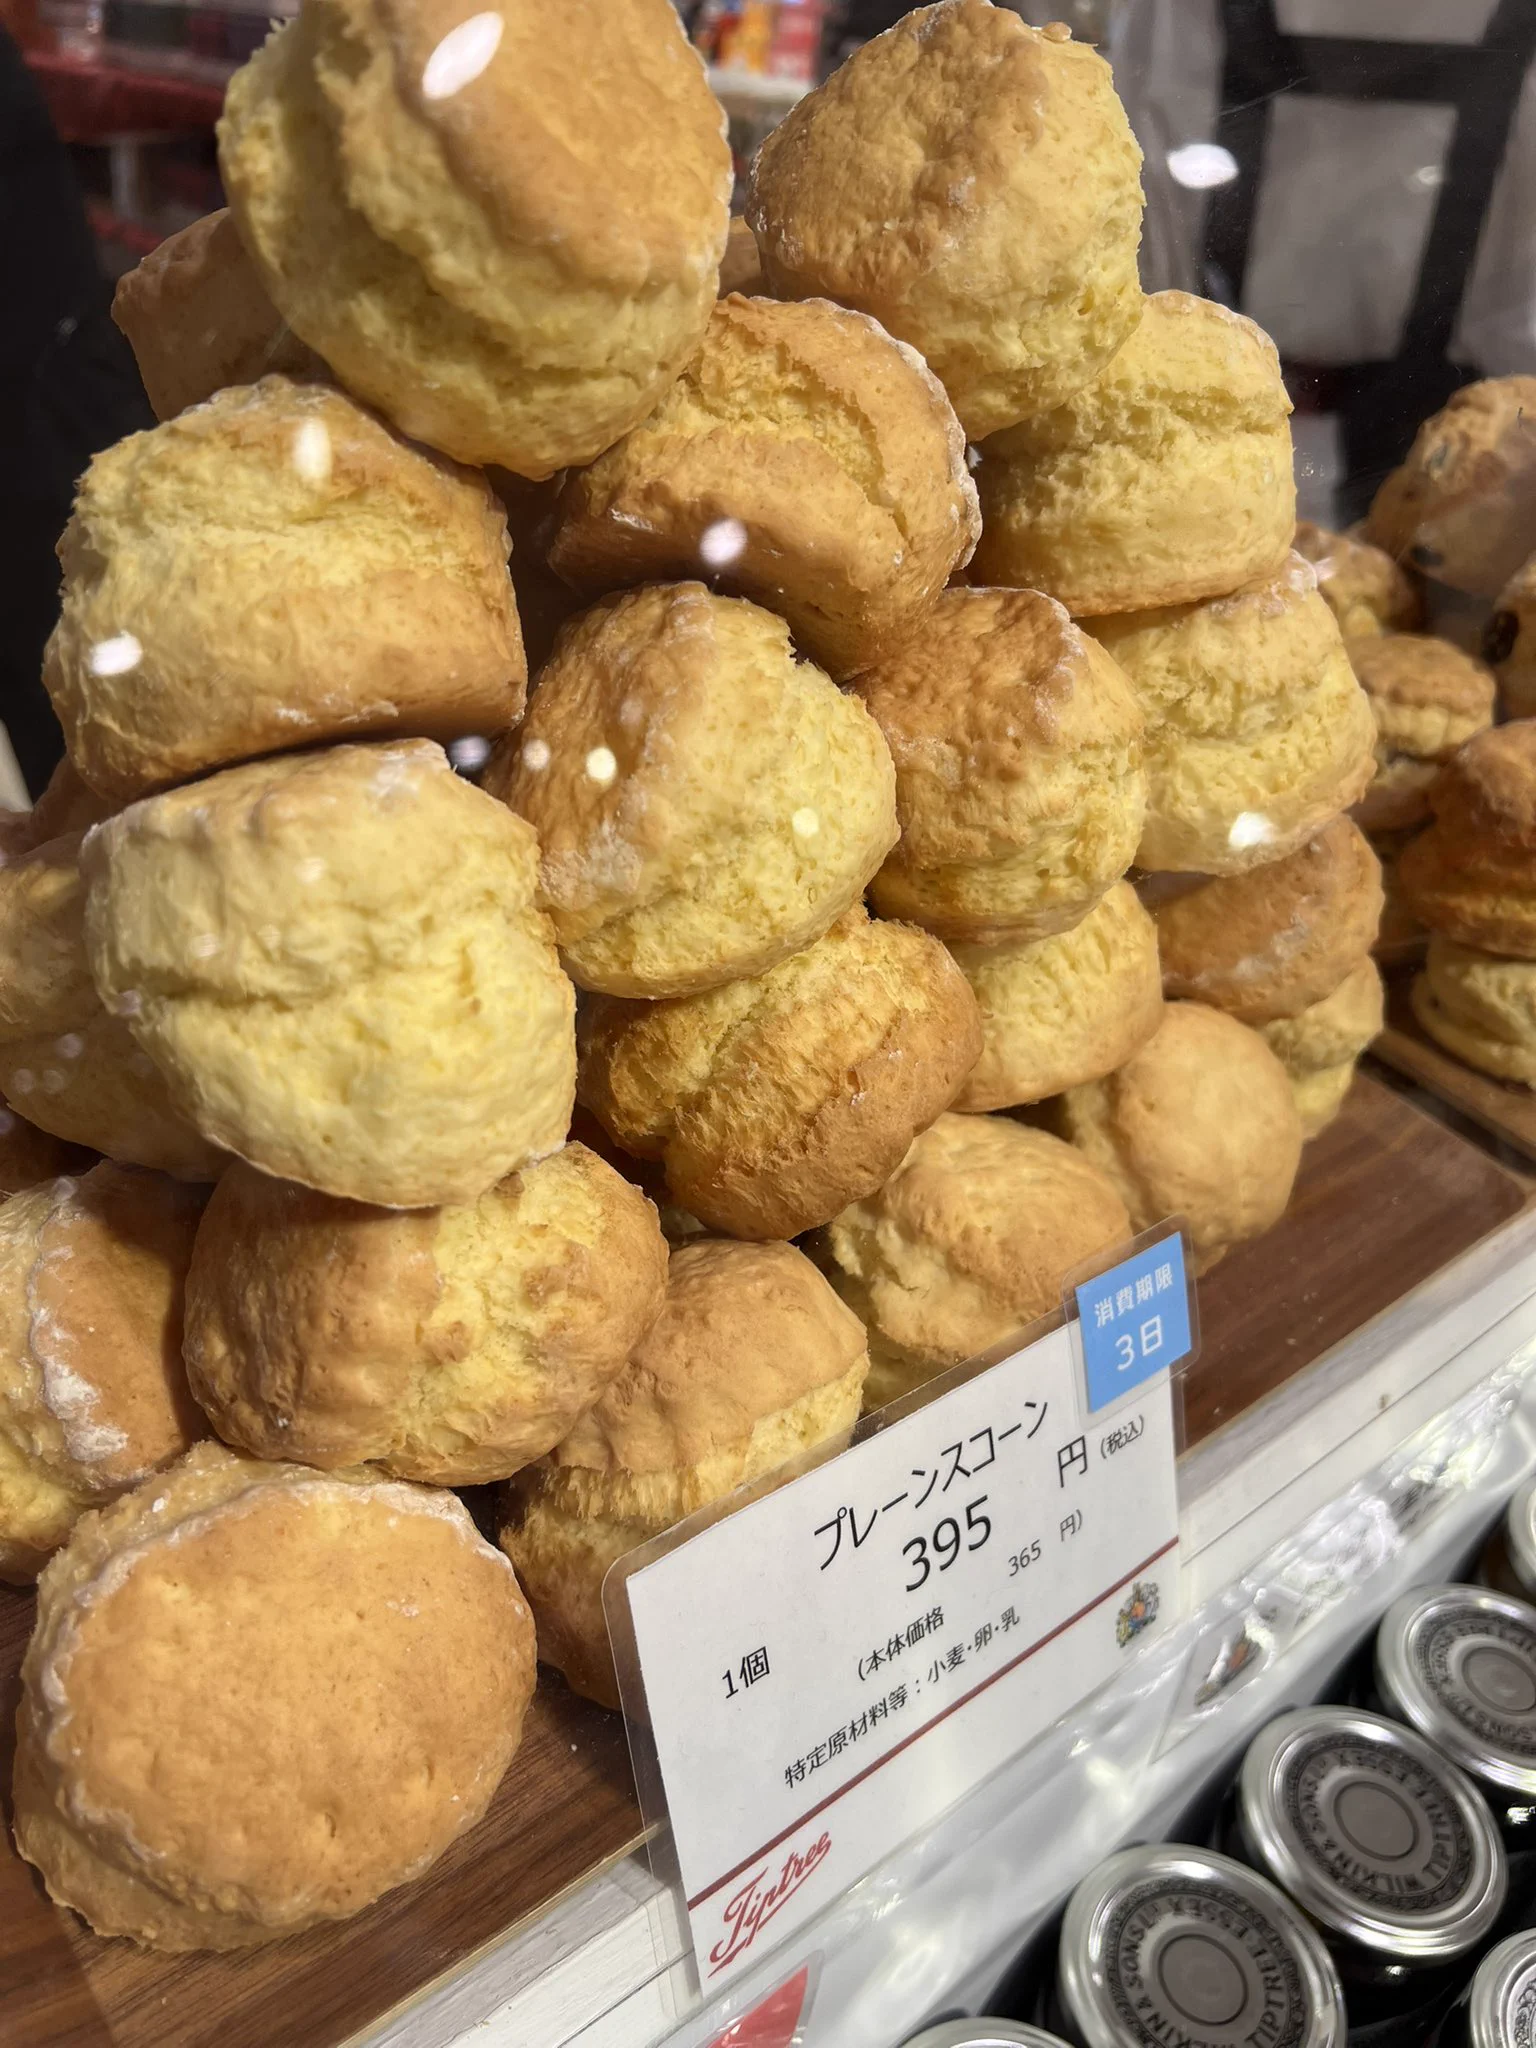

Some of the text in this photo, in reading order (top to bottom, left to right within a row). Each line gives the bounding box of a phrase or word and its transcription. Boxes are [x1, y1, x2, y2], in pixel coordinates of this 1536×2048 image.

[1094, 1262, 1173, 1328] 消費期限
[1115, 1314, 1163, 1371] 3日
[814, 1402, 1048, 1571] プレーンスコーン
[722, 1646, 770, 1699] 1個
[902, 1495, 991, 1592] 395
[858, 1606, 944, 1681] (本体価格
[1008, 1540, 1041, 1577] 365
[708, 1832, 832, 1978] Tiptree
